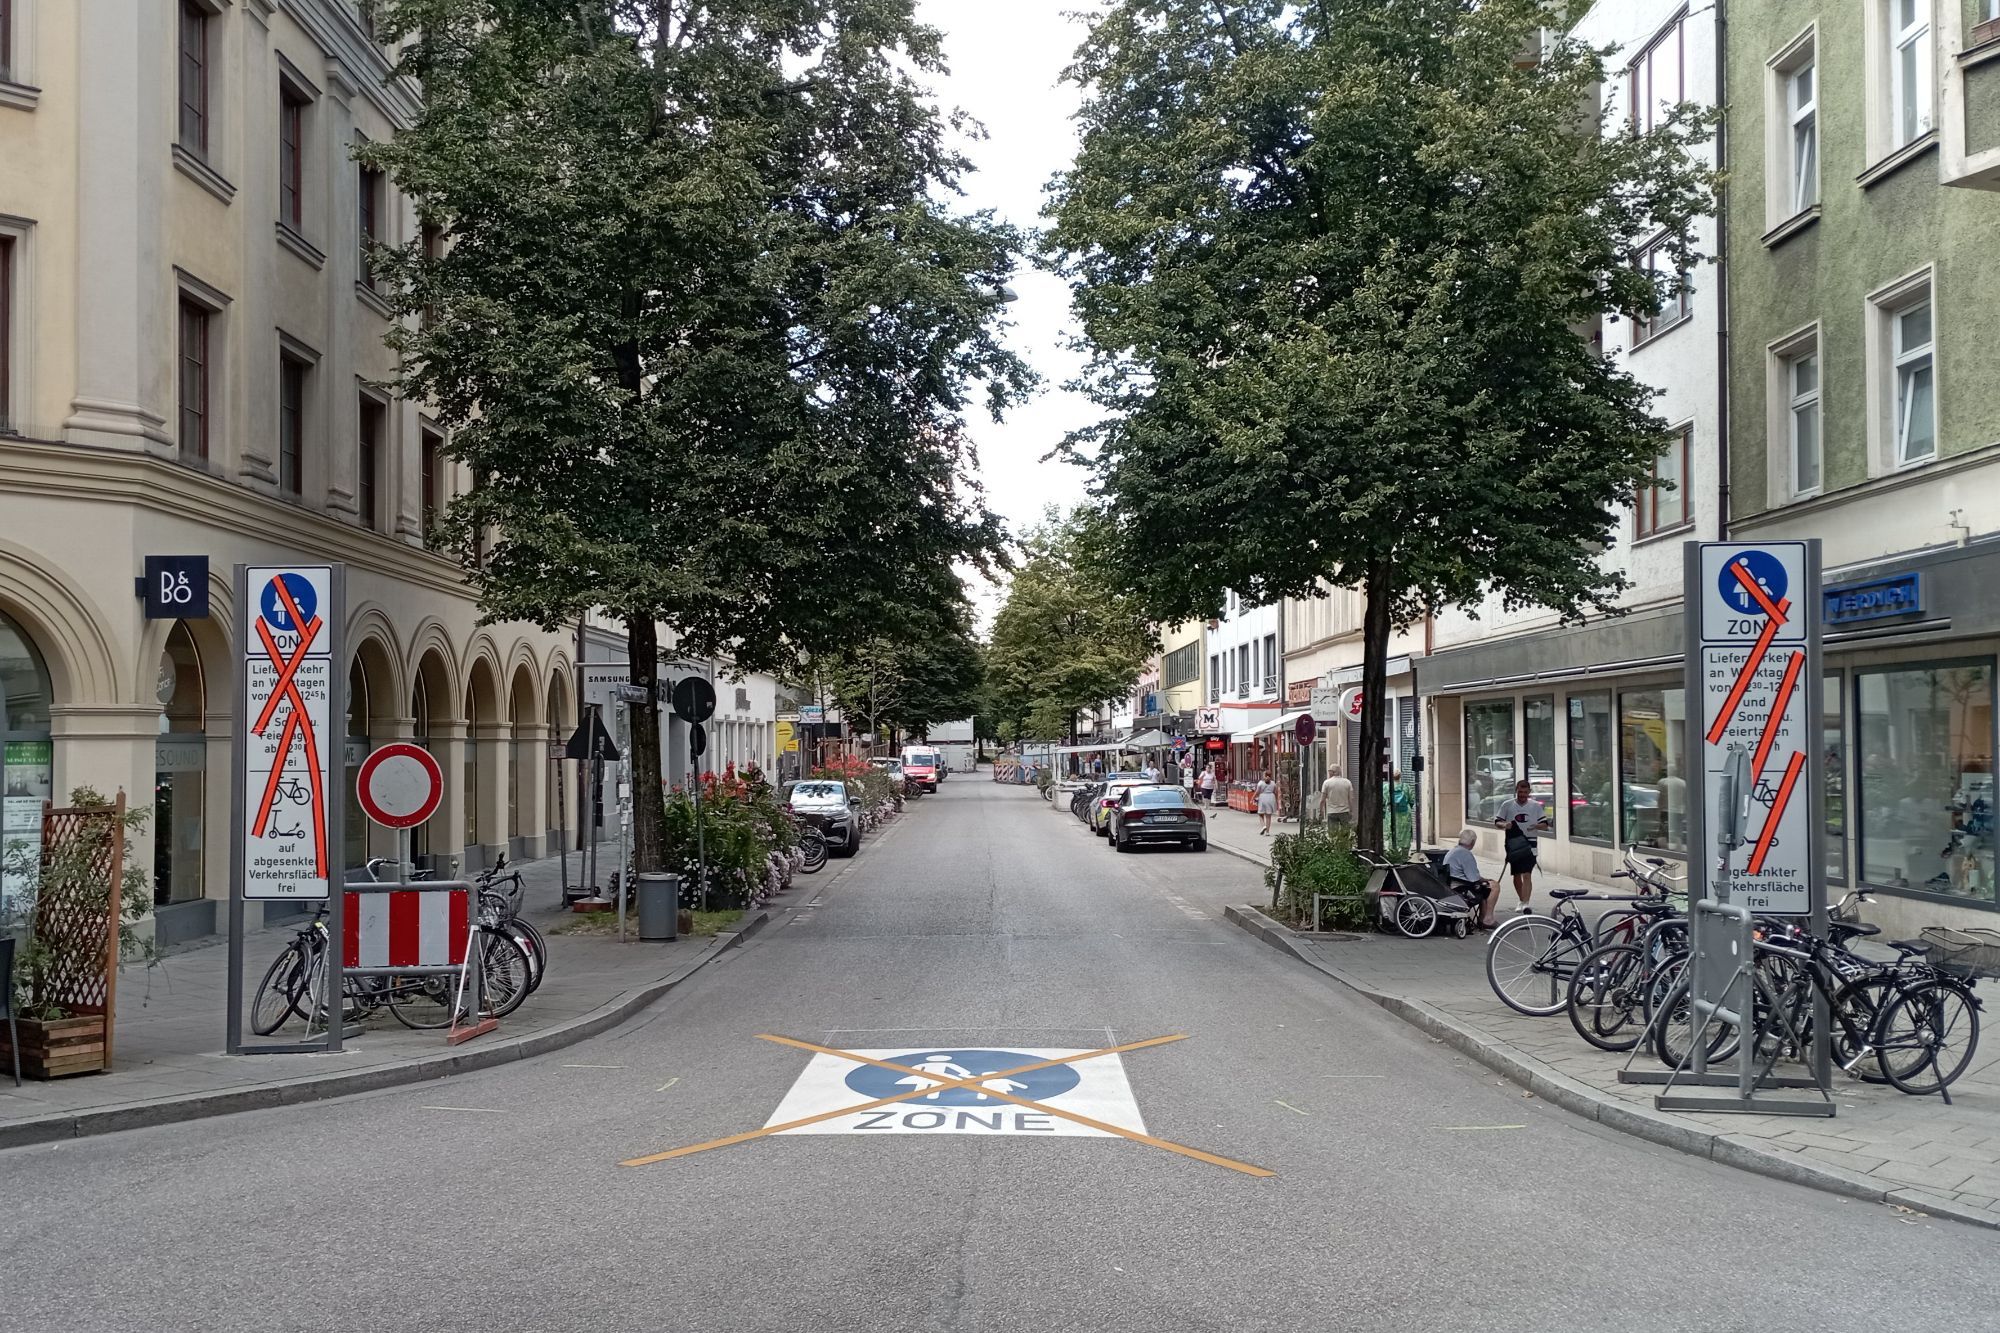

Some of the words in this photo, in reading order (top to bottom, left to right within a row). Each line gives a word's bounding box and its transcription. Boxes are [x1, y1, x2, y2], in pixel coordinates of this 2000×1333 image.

[1727, 620, 1780, 635] ZON
[269, 635, 301, 649] ON
[252, 665, 324, 675] Liefekehr
[1709, 669, 1725, 678] an
[1731, 668, 1785, 680] Wktag
[252, 680, 265, 688] an
[269, 678, 325, 689] Wtagen
[1709, 684, 1732, 693] von
[1743, 697, 1766, 707] und
[1203, 713, 1215, 724] M
[264, 744, 277, 753] ab
[279, 843, 296, 853] auf
[254, 857, 318, 868] abgesenkte
[249, 870, 319, 880] Verkehrsfläch
[278, 883, 296, 893] frei
[1747, 896, 1769, 907] frei
[852, 1111, 1055, 1131] ZONE
